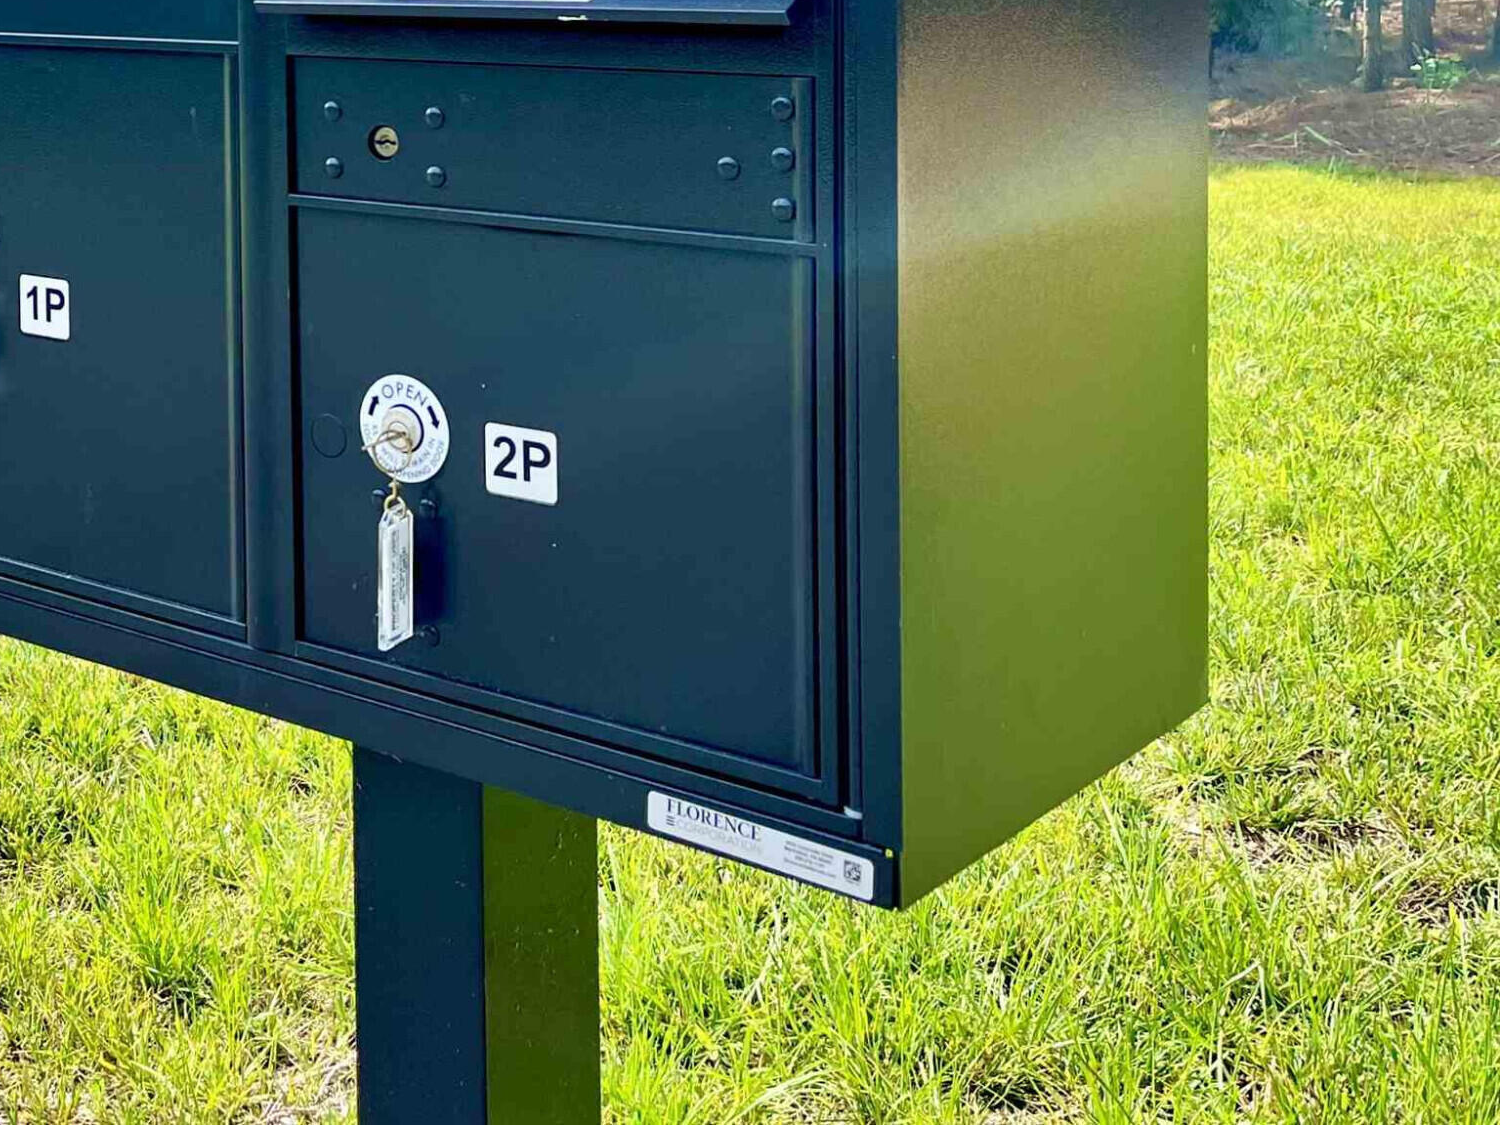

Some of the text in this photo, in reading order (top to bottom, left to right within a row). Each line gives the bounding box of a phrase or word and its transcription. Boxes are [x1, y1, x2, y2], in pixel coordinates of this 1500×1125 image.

[26, 285, 65, 323] 1P
[381, 382, 428, 407] OPEN
[493, 436, 551, 482] 2P
[666, 798, 764, 842] FLORENCE
